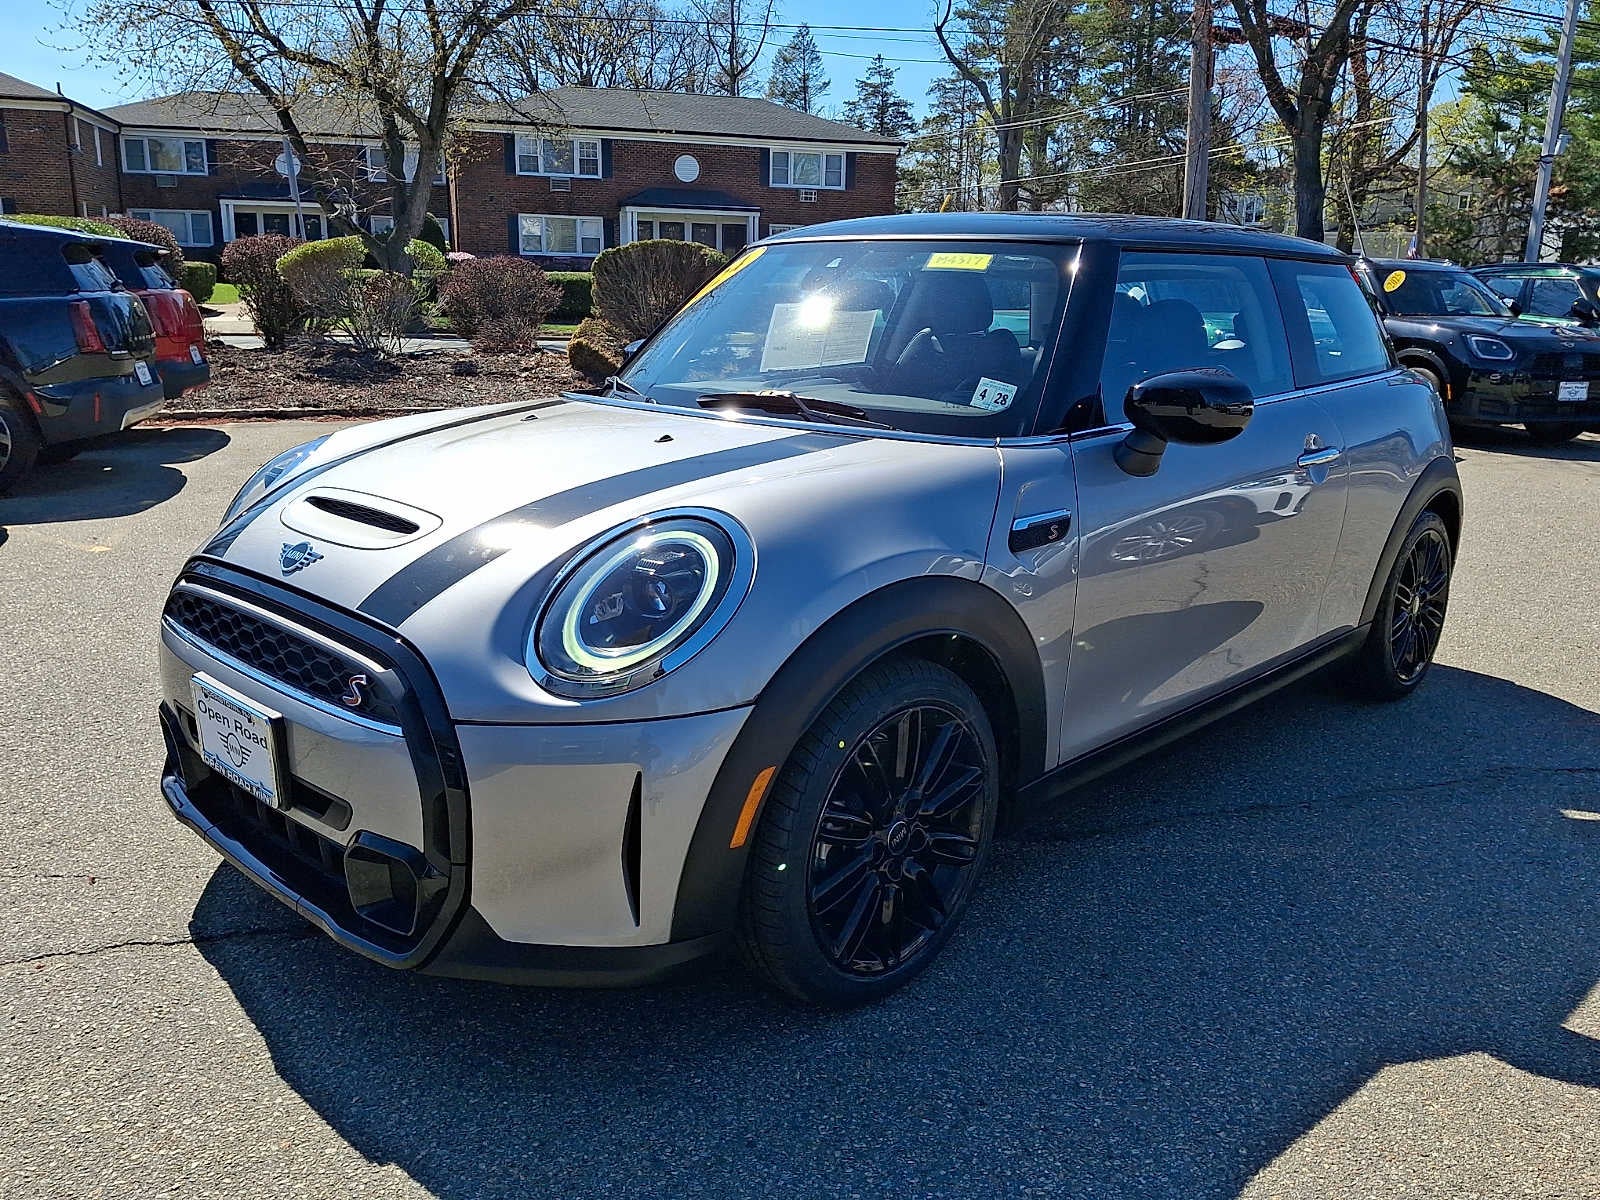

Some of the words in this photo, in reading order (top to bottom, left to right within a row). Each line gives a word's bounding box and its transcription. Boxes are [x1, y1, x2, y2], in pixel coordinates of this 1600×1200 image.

[979, 388, 989, 401] 4
[993, 392, 1009, 406] 28
[1048, 524, 1059, 540] S
[342, 674, 367, 706] S
[197, 700, 231, 729] Open
[234, 719, 268, 750] Road
